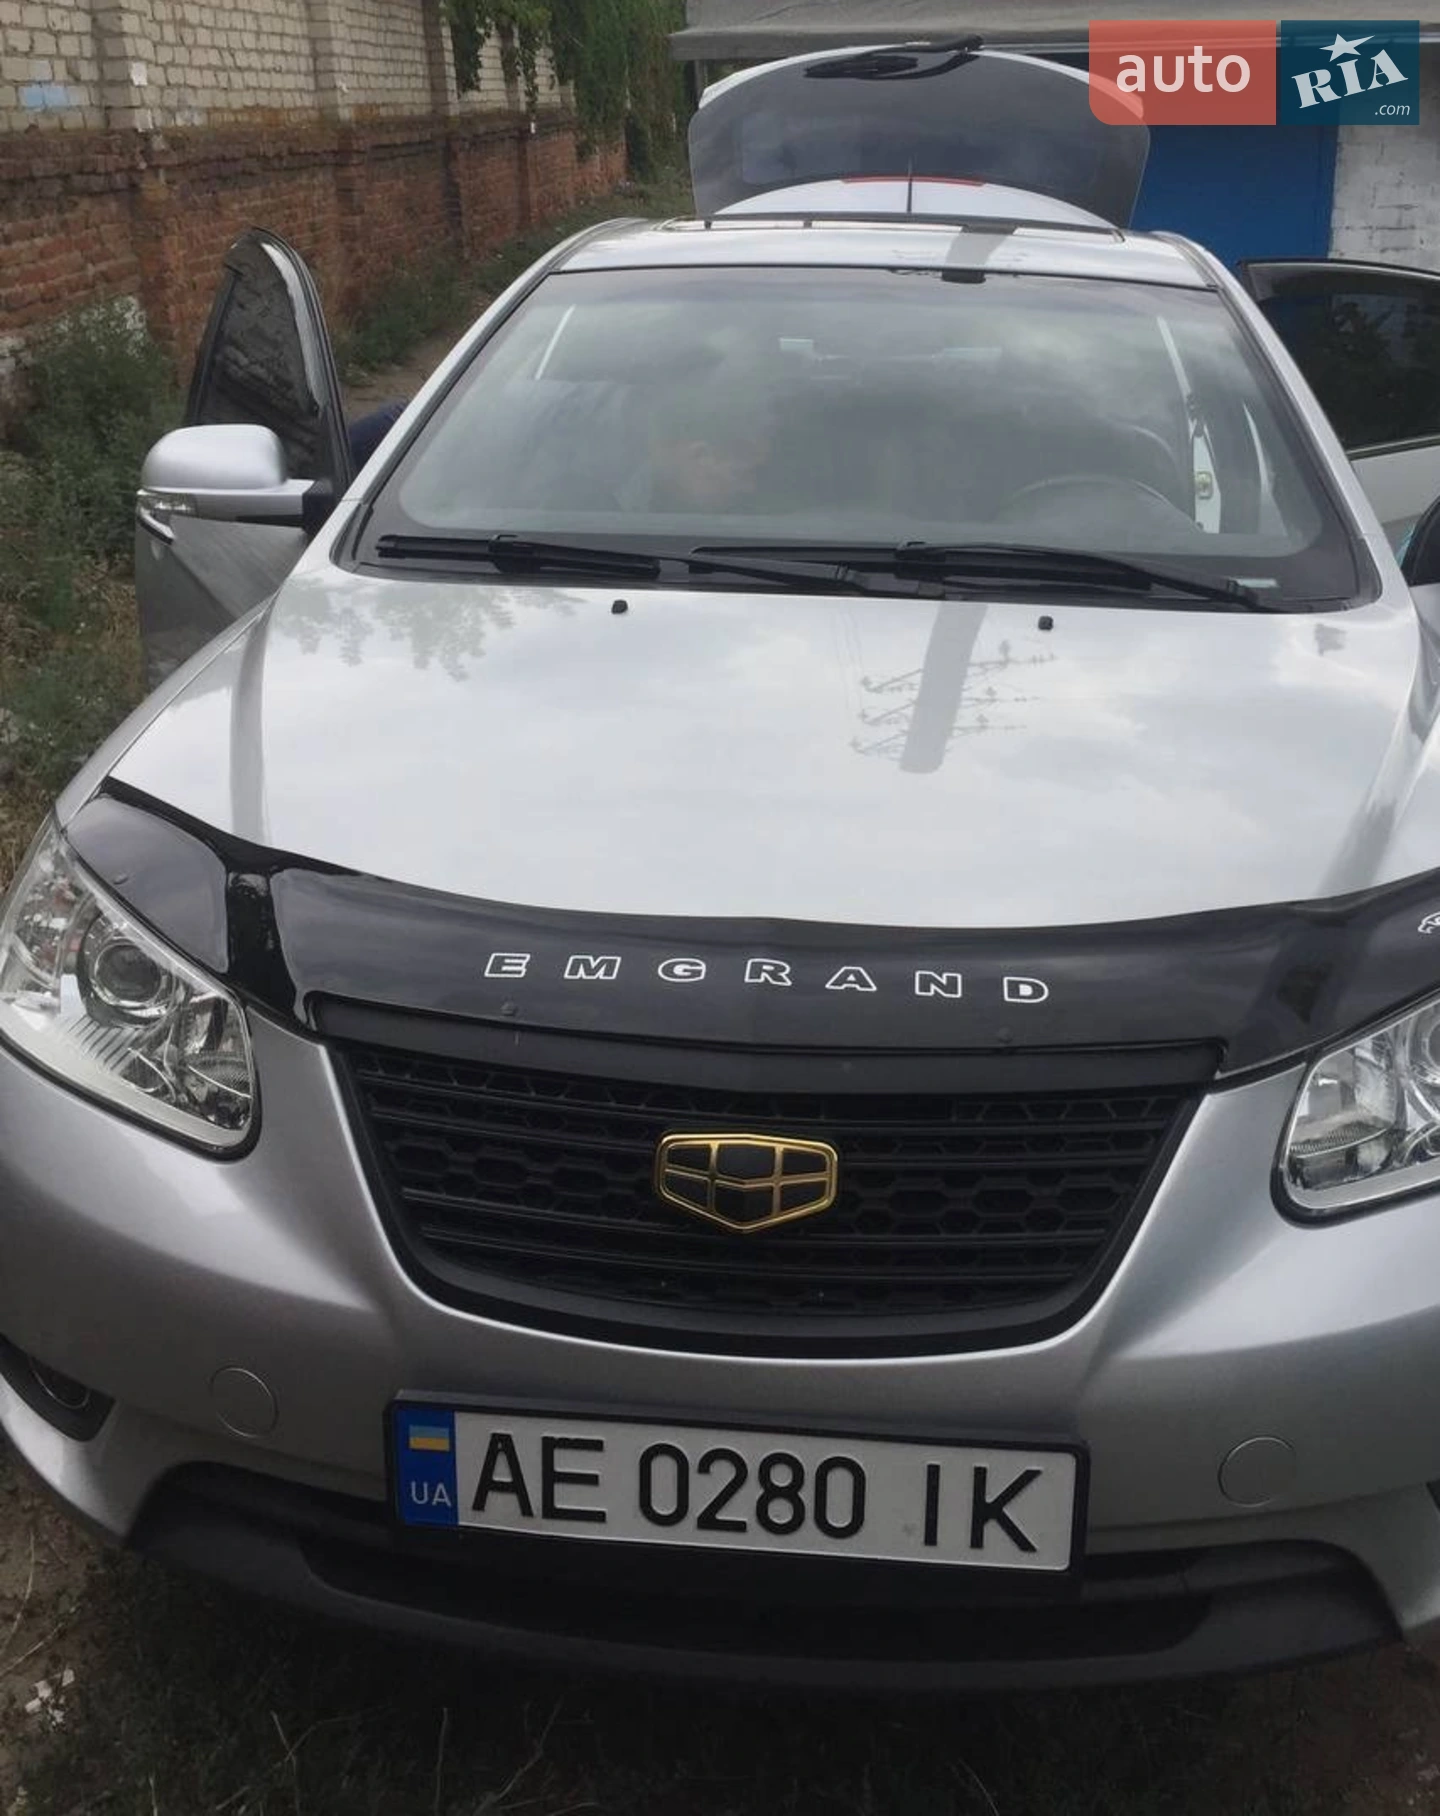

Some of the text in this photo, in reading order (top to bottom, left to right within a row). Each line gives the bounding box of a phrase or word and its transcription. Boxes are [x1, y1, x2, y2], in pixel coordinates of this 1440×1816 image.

[484, 953, 1049, 1003] EMGRAND
[411, 1481, 452, 1507] UA
[471, 1433, 1043, 1553] AE 0280 IK
